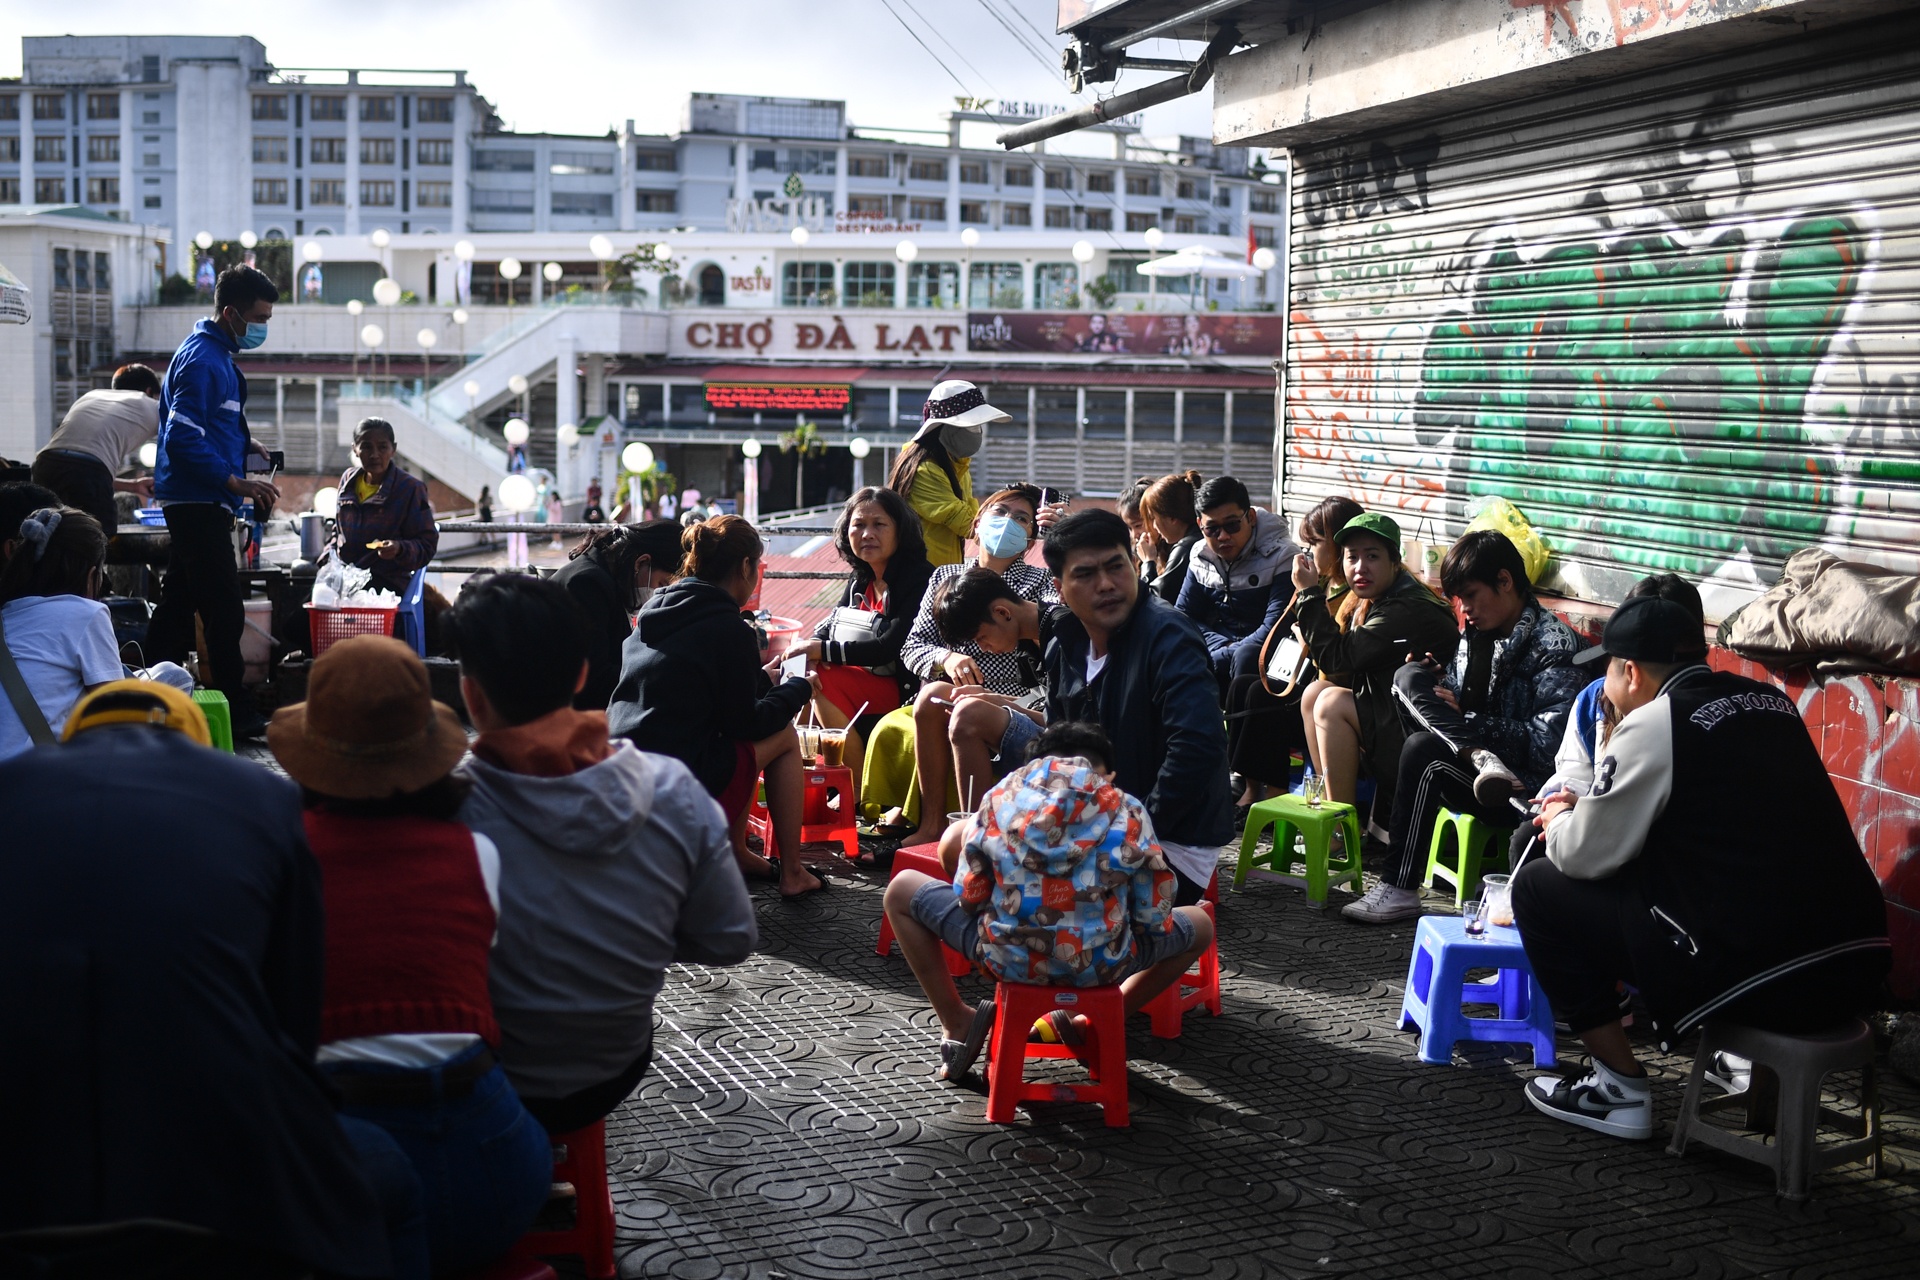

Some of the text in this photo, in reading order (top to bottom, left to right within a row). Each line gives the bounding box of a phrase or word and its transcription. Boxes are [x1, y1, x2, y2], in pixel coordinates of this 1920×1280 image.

[730, 275, 772, 291] TASTY
[686, 315, 961, 356] CHỢ ĐÀ LẠT
[1689, 692, 1798, 731] NEW YORK
[1592, 754, 1619, 797] 3
